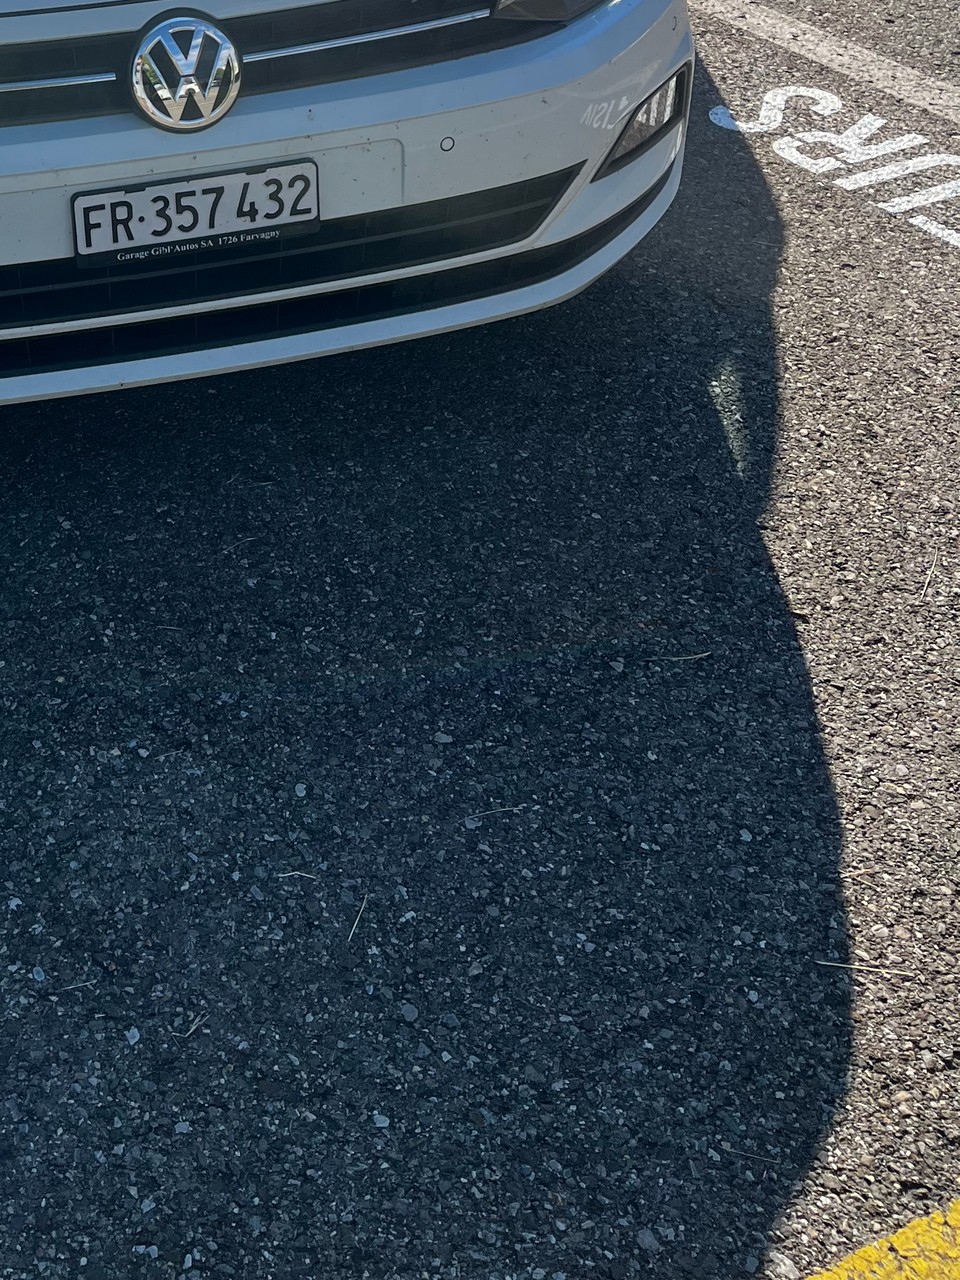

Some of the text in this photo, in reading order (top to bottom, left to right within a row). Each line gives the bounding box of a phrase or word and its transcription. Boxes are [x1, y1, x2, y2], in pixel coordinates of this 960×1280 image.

[136, 20, 238, 125] VW
[116, 250, 150, 261] Garage
[200, 239, 214, 249] SA
[217, 235, 238, 245] 1726
[240, 230, 281, 242] Farvagny
